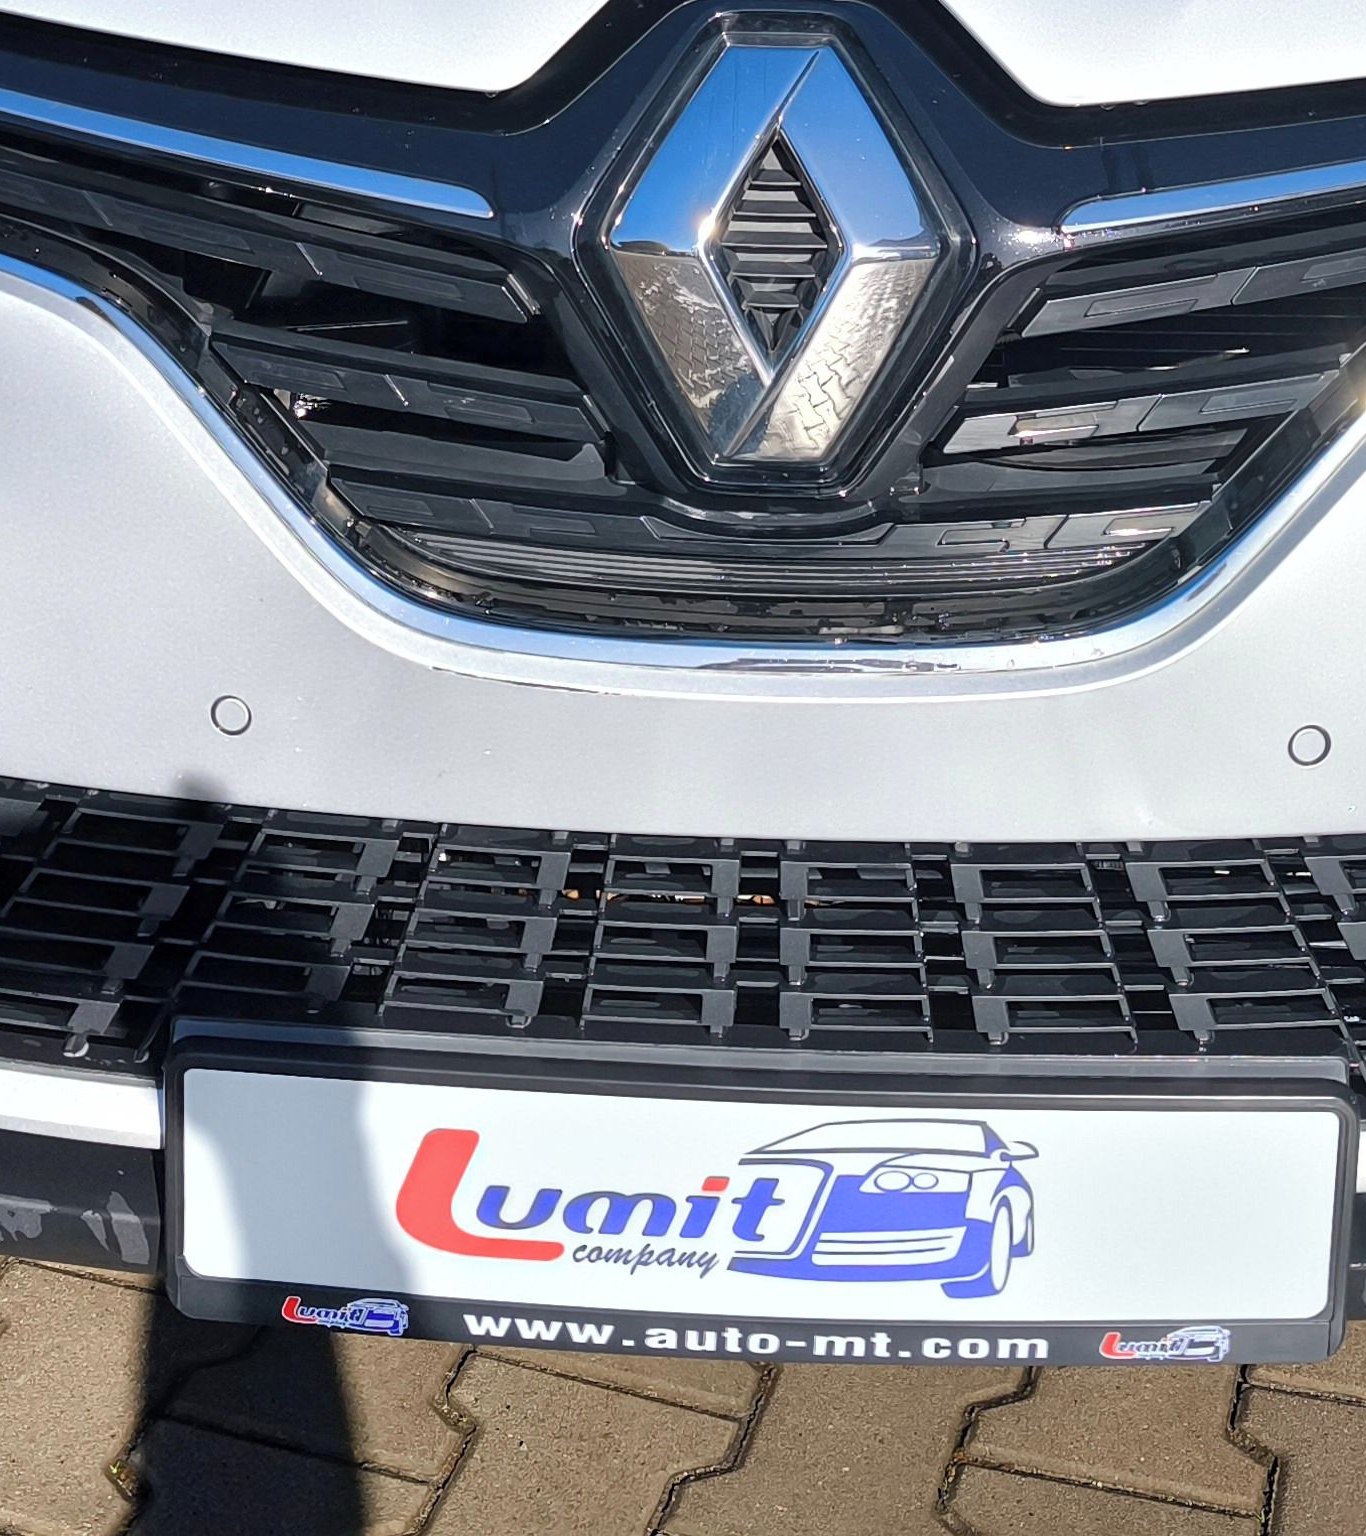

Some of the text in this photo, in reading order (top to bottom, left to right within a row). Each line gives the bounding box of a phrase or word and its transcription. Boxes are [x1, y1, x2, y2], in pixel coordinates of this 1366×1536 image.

[396, 1128, 785, 1262] Lumit
[572, 1243, 720, 1278] company
[462, 1313, 1049, 1360] www.auto-mt.com
